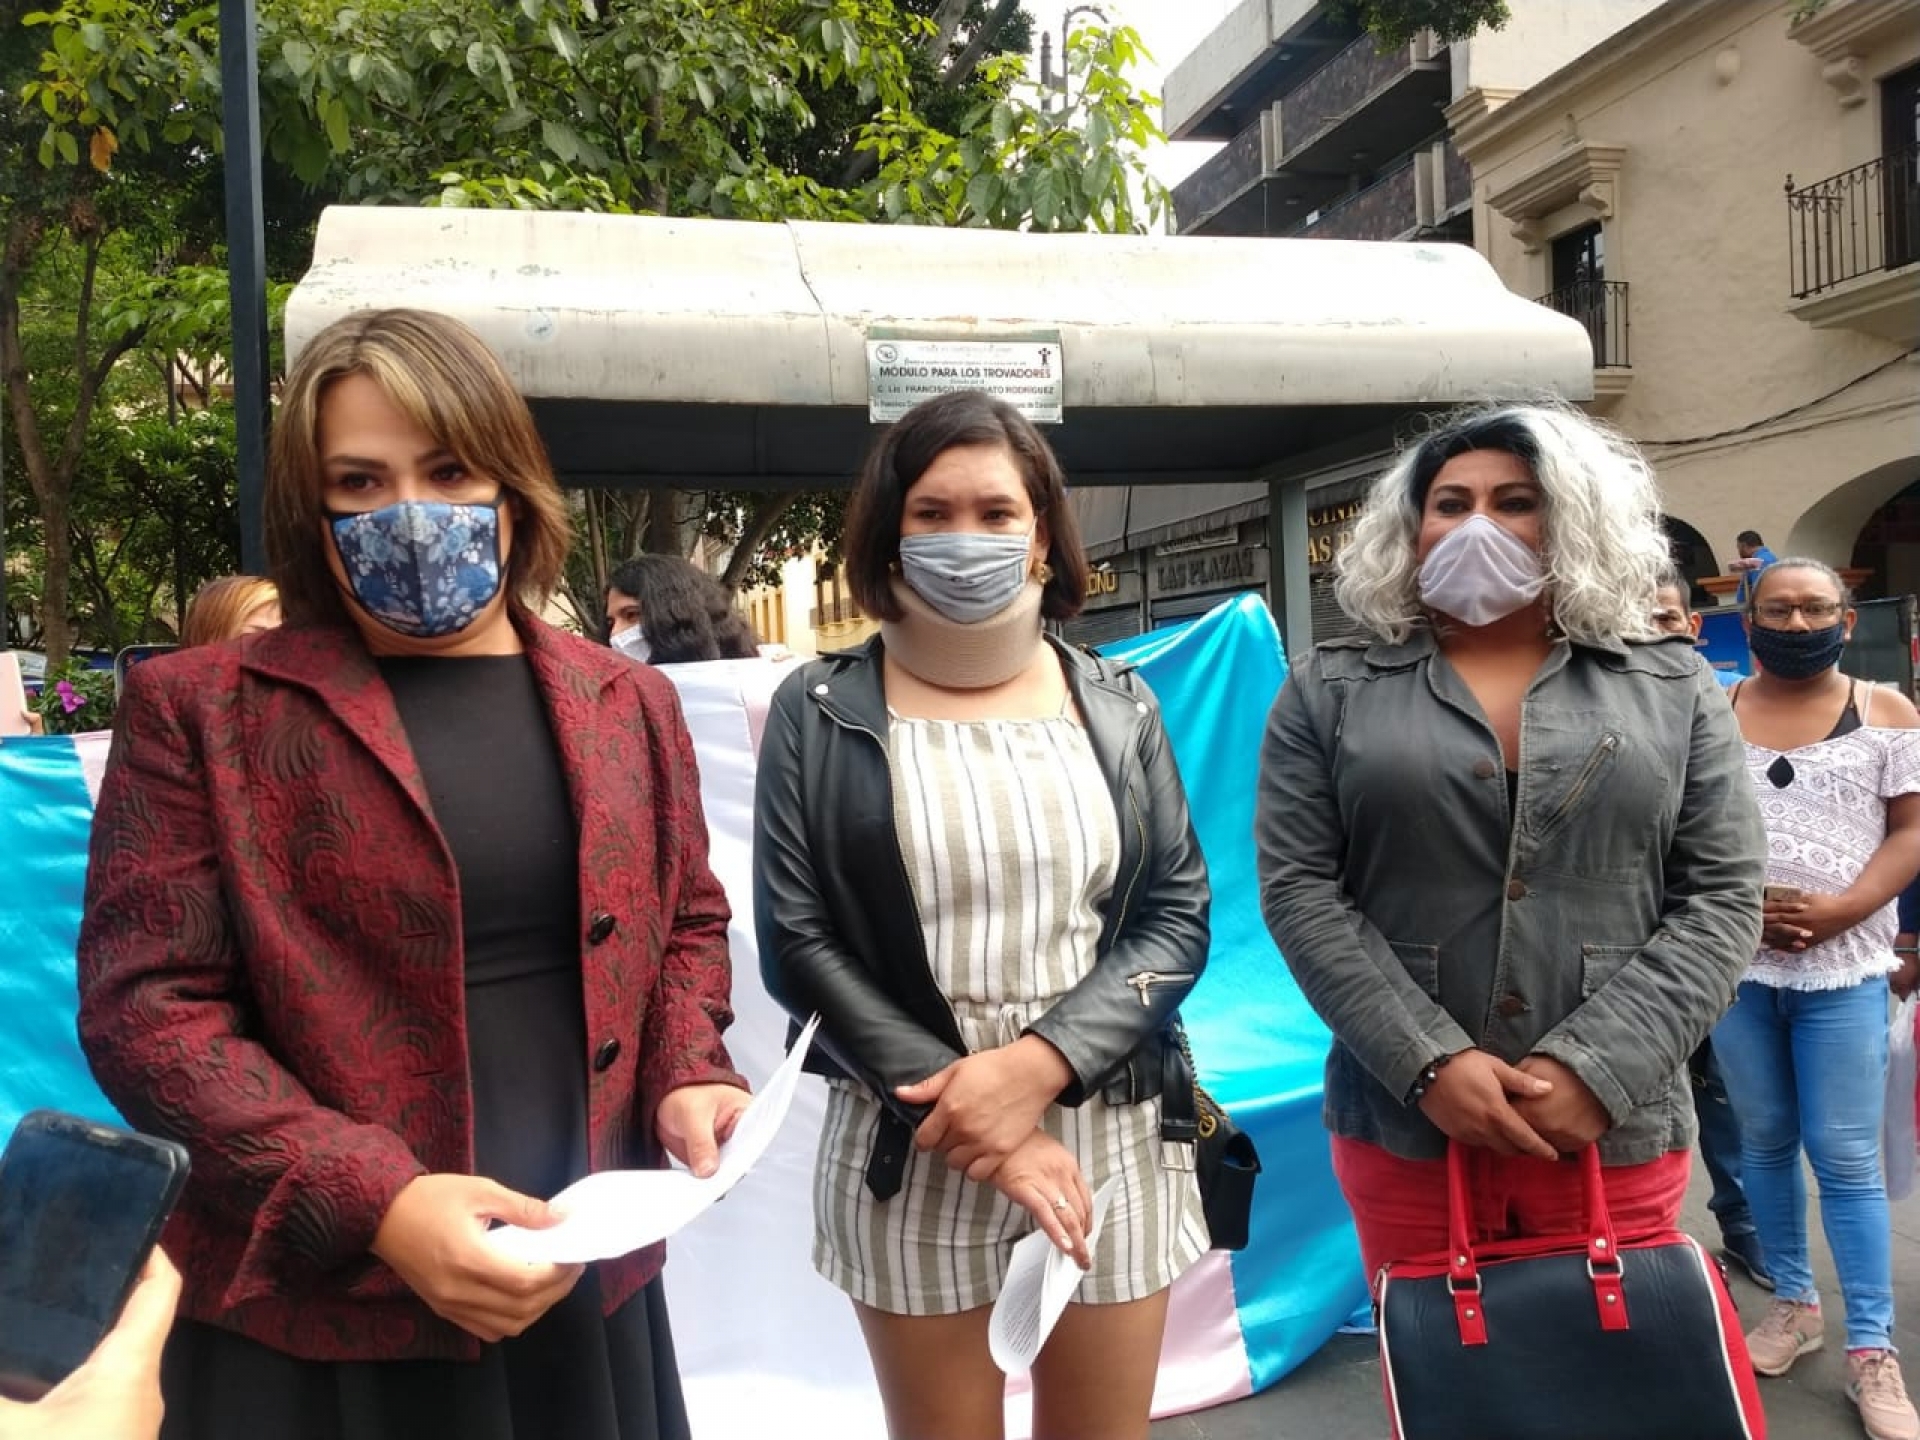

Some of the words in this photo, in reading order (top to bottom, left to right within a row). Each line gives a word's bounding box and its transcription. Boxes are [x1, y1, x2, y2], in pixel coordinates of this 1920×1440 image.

[931, 366, 958, 377] PARA
[961, 367, 980, 378] LOS
[984, 368, 1050, 379] TROVADORES
[1158, 564, 1186, 590] LAS
[1188, 549, 1254, 585] PLAZAS
